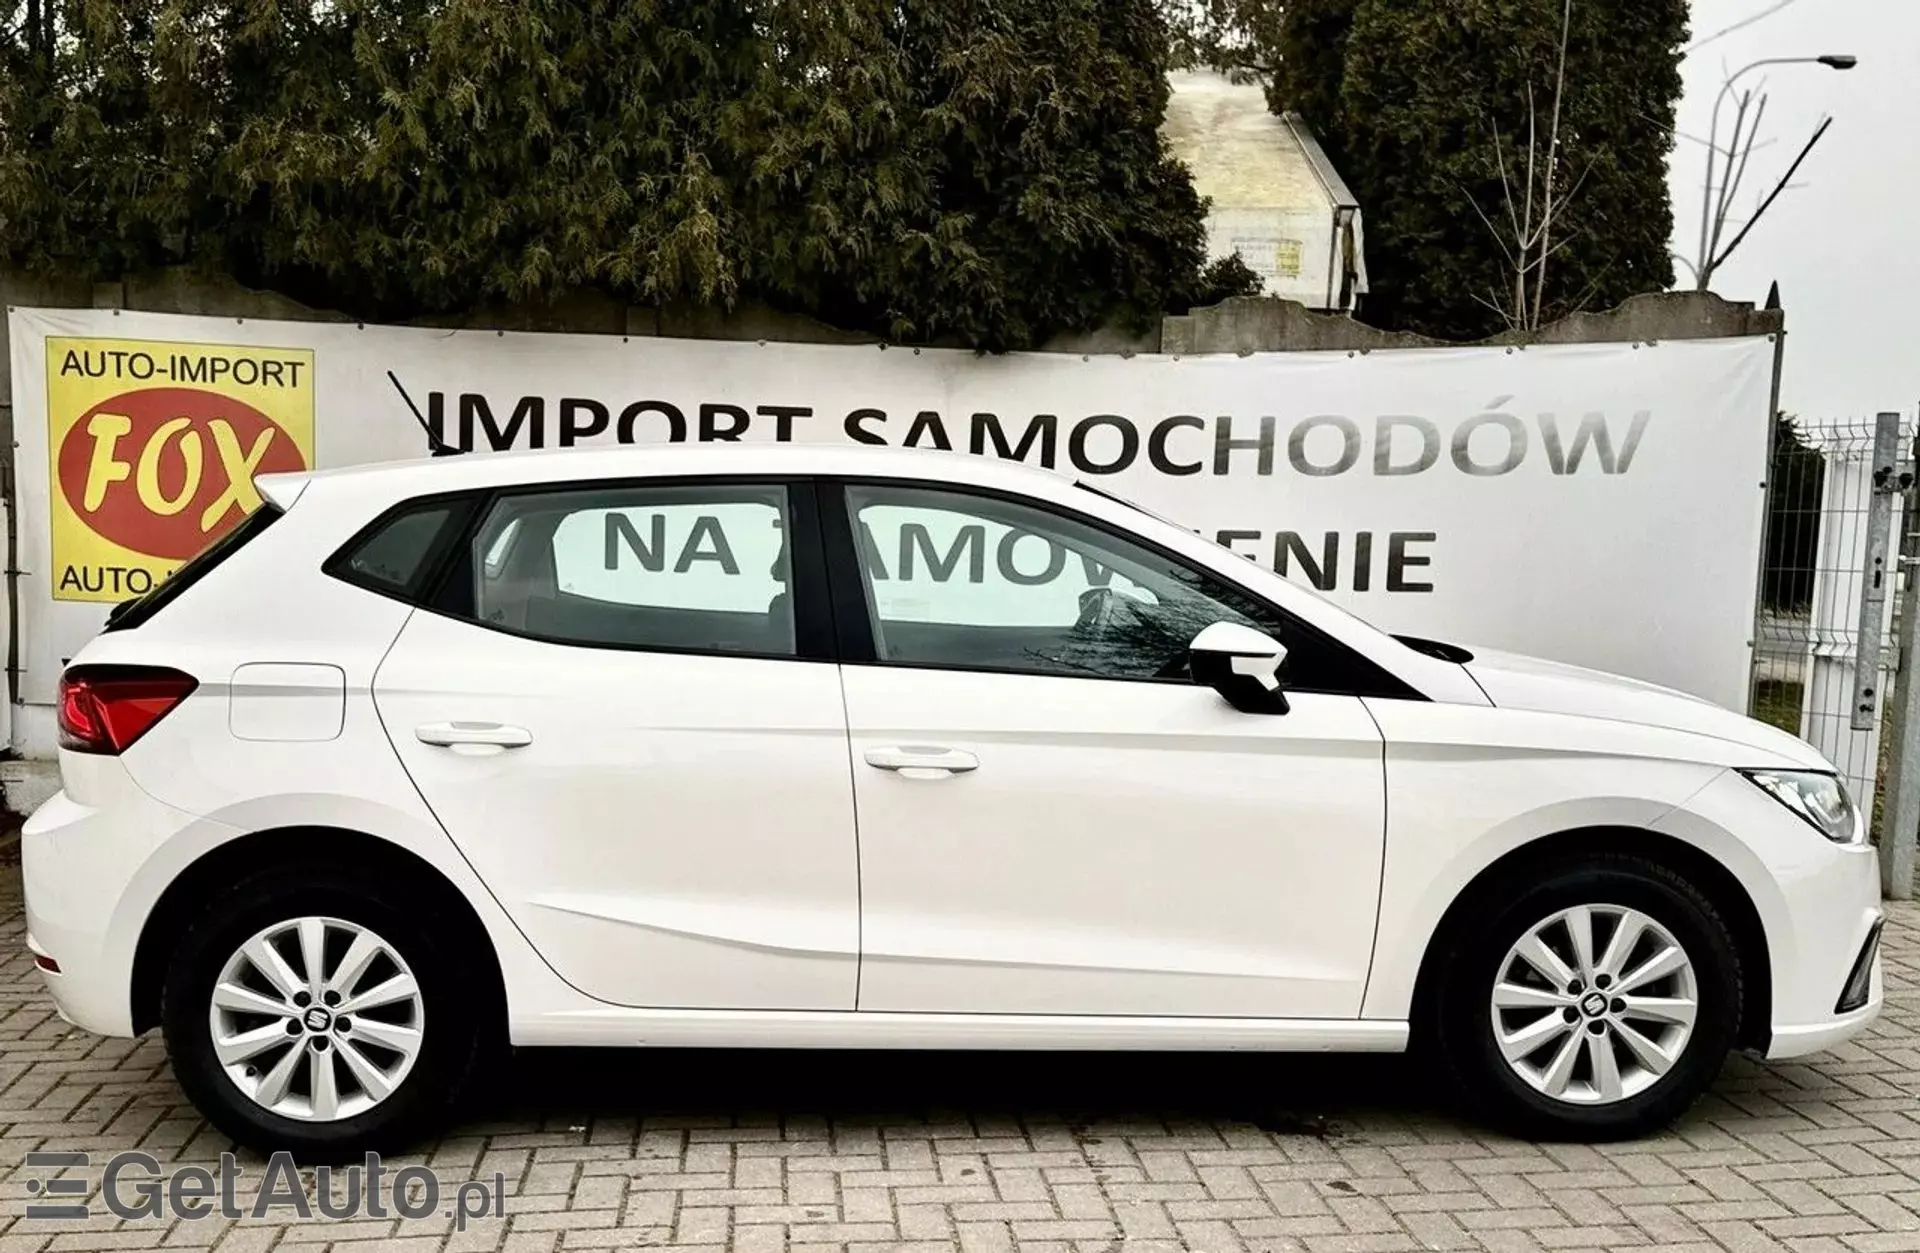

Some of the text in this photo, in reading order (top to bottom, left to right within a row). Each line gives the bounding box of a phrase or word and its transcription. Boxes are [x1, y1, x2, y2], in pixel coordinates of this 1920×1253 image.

[60, 350, 306, 388] AUTO-IMPORT
[428, 391, 1651, 477] IMPORT SAMOCHODÓW
[83, 412, 276, 533] FOX
[603, 511, 741, 576] NA
